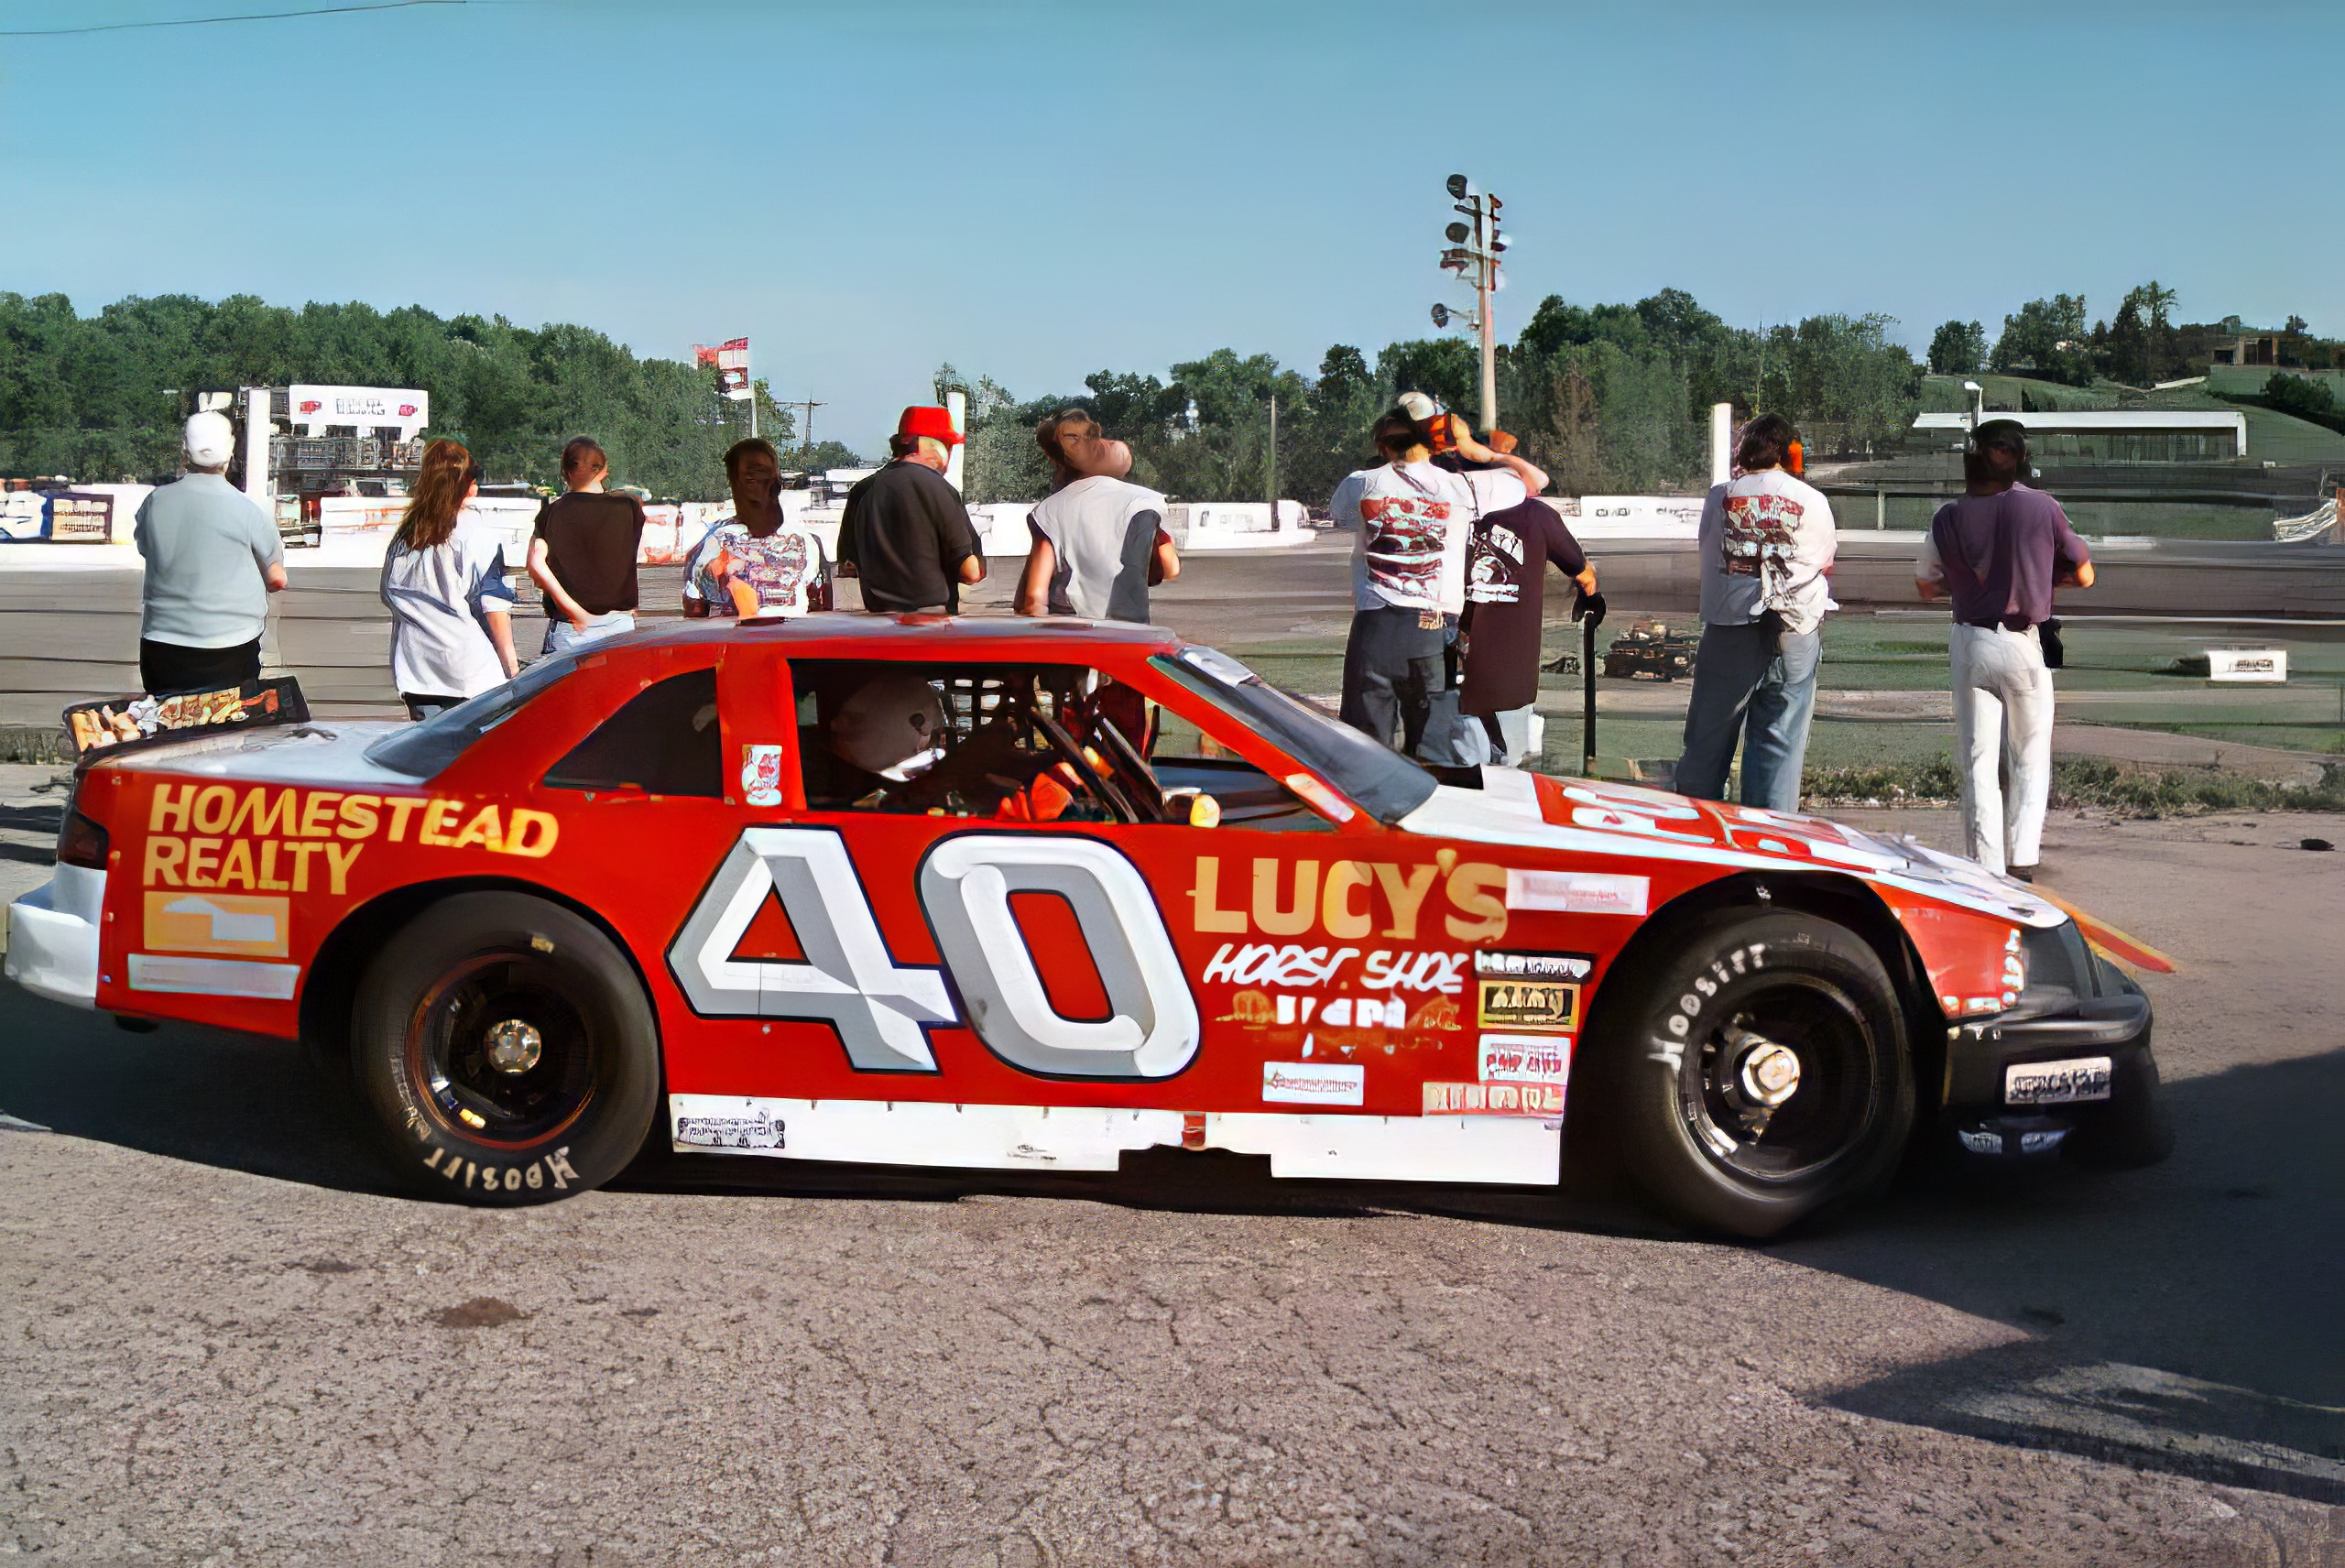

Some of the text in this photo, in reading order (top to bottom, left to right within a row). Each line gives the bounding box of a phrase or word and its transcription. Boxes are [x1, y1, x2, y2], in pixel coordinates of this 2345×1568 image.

[148, 783, 560, 859] HOMESTEAD
[143, 834, 365, 896] REALTY
[1187, 847, 1509, 944] LUCY'S
[663, 824, 1202, 1084] 40
